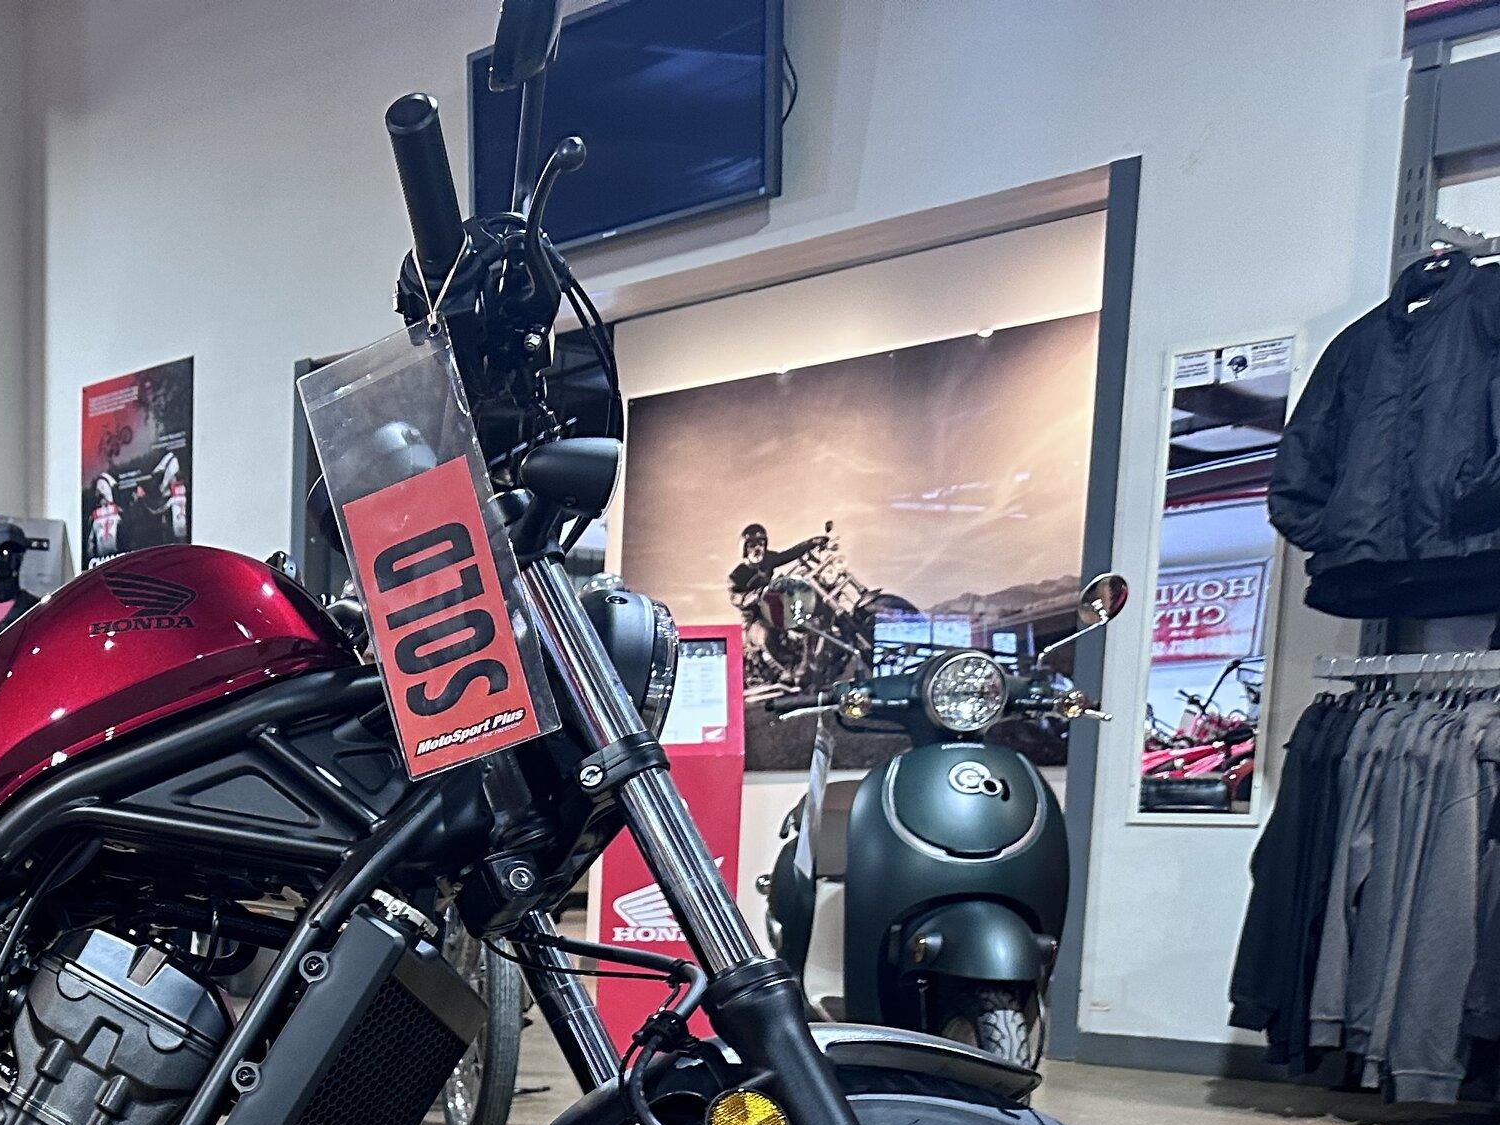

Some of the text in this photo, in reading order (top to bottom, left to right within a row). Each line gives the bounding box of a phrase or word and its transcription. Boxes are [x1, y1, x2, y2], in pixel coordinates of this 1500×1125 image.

[88, 615, 197, 636] HONDA
[374, 522, 509, 717] SOLD
[415, 708, 525, 756] MotoSport Plus
[612, 926, 687, 942] HON
